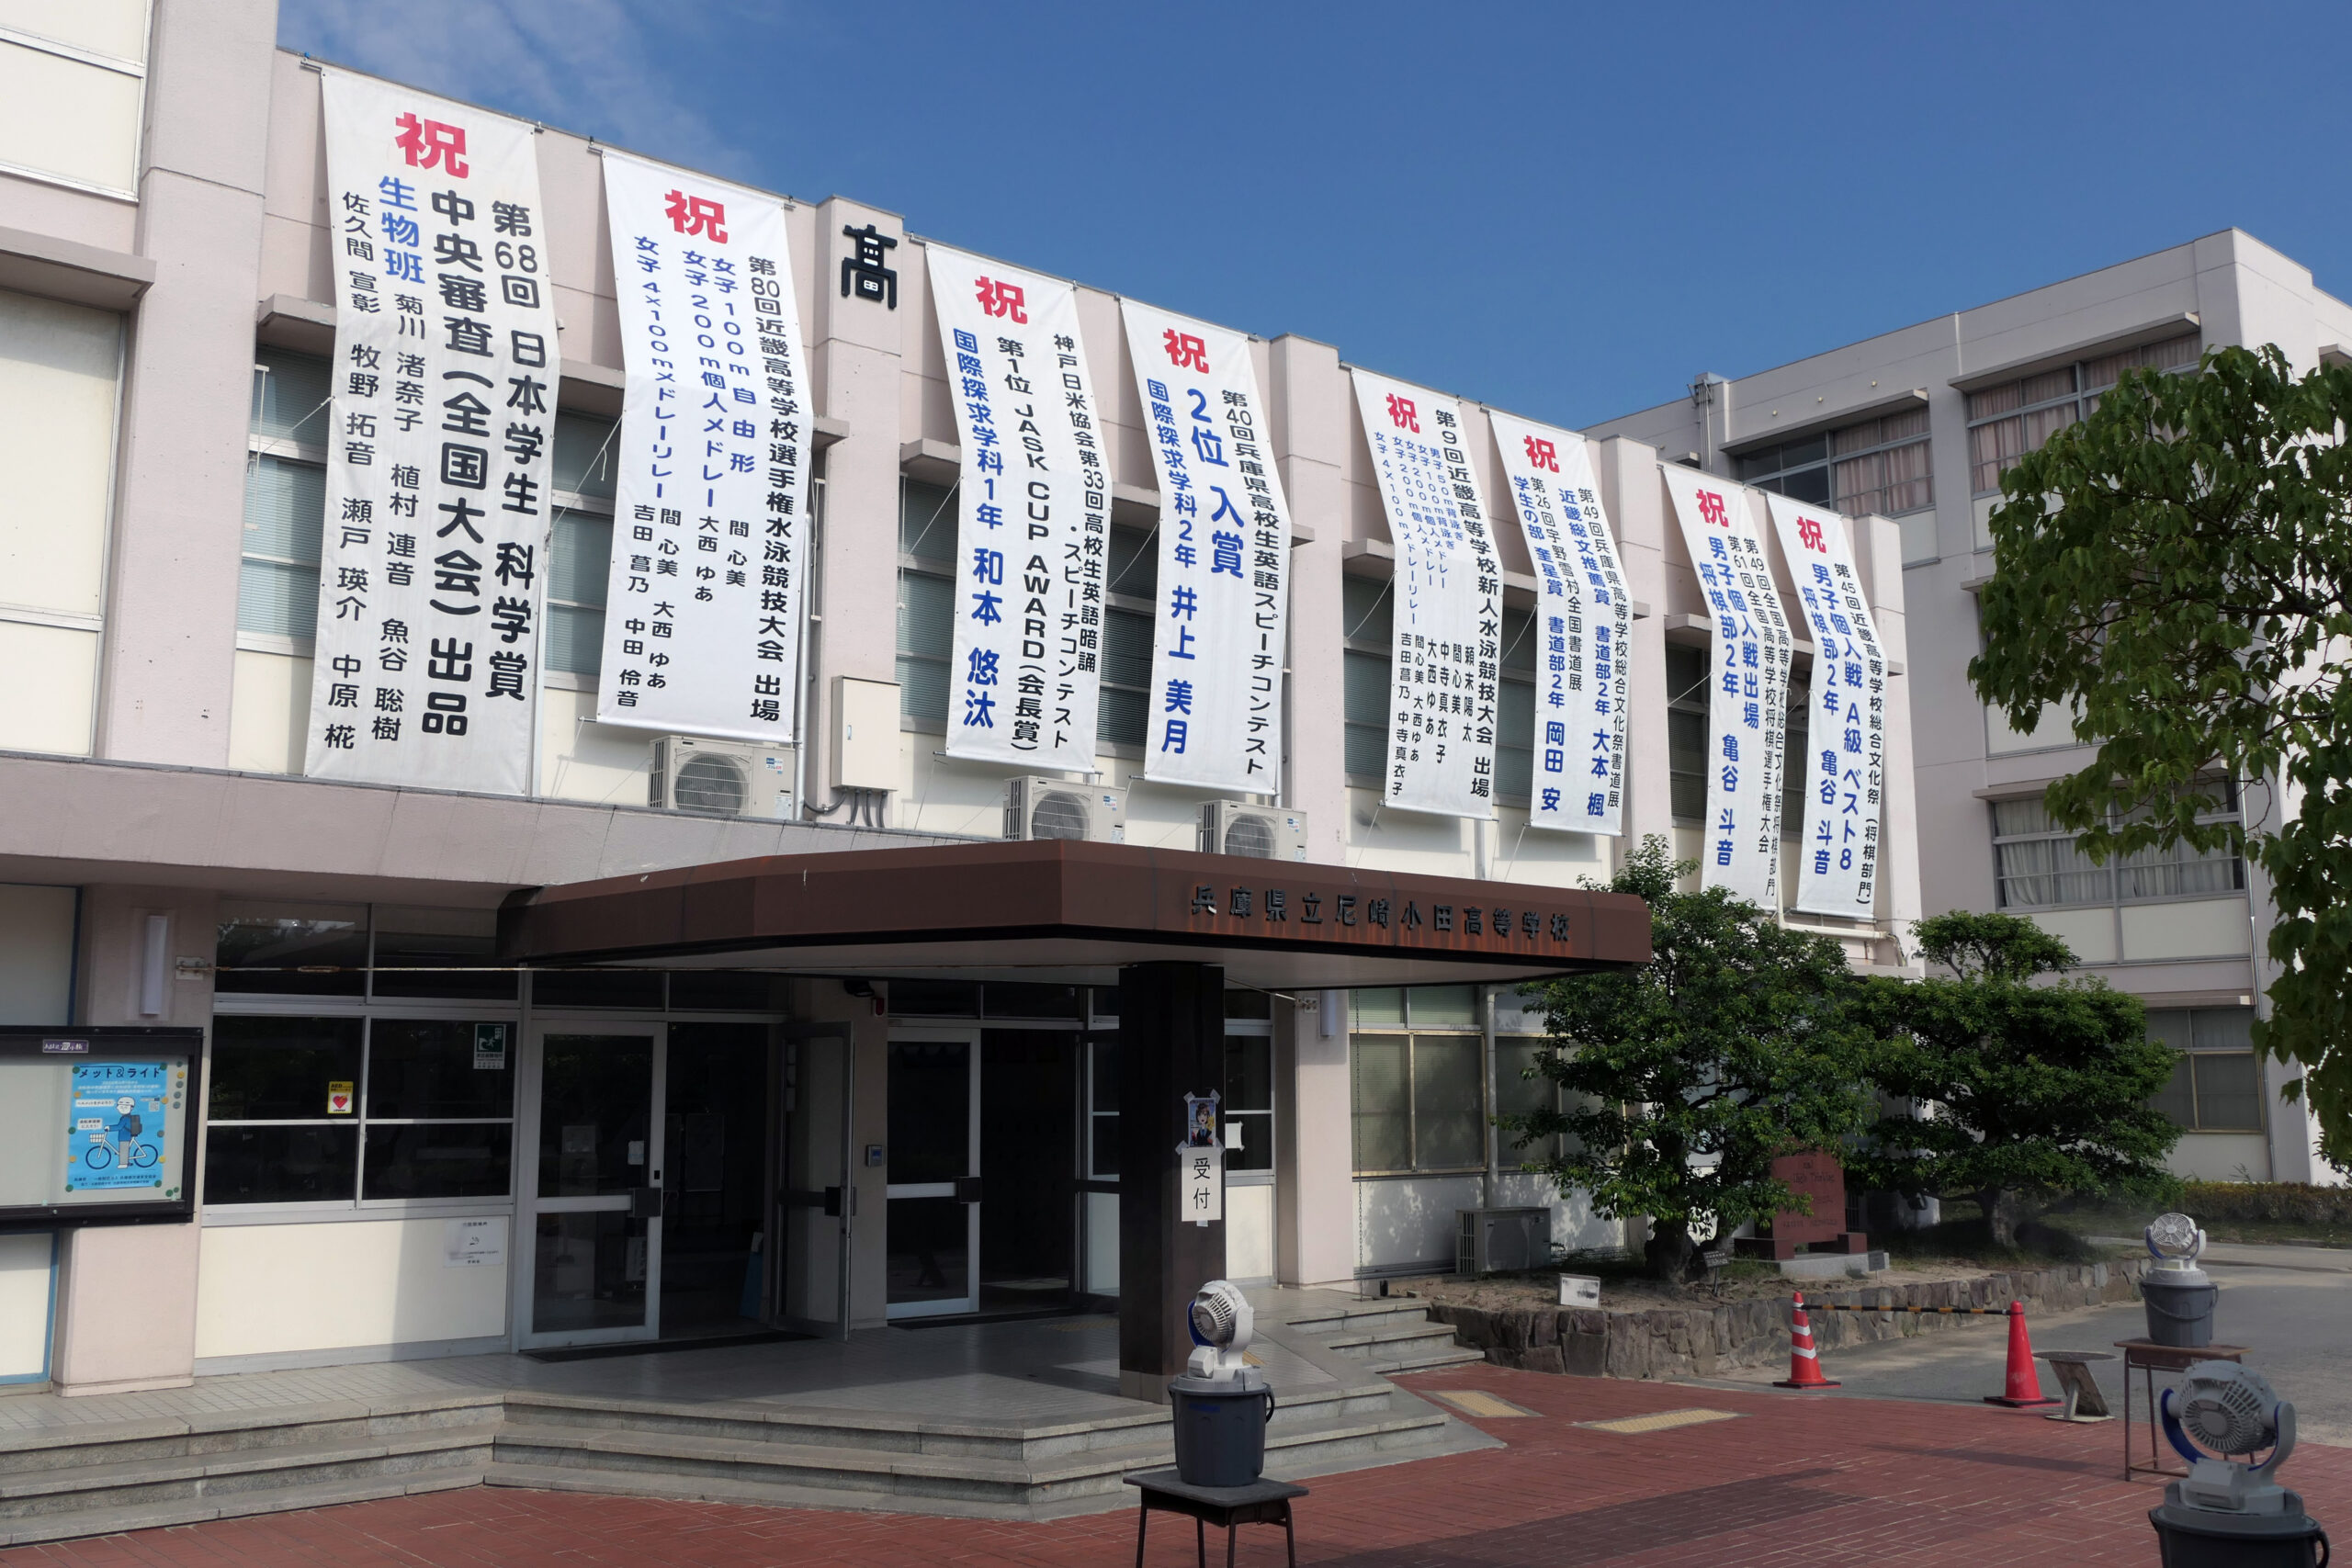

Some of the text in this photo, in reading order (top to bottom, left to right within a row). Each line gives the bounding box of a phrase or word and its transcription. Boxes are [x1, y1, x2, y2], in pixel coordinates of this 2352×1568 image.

[394, 112, 469, 182] 祝
[343, 192, 373, 261] 佐久間
[379, 176, 425, 284] 生物班
[665, 189, 728, 243] 祝
[394, 294, 424, 339] 菊川
[975, 276, 1027, 324] 祝
[348, 344, 380, 398] 牧野
[997, 337, 1033, 394] 第1位
[1163, 329, 1209, 374] 祝
[394, 352, 425, 432] 渚奈子
[1386, 393, 1419, 434] 祝
[345, 412, 377, 466] 拓音
[1015, 404, 1048, 470] JASK
[1523, 435, 1559, 473] 祝
[390, 464, 420, 517] 植村
[1187, 389, 1244, 579] 2位 入賞
[1696, 490, 1729, 527] 祝
[633, 505, 655, 541] 吉田
[698, 516, 718, 552] 大西
[1028, 482, 1049, 540] CUP
[1797, 516, 1826, 553] 祝
[386, 532, 415, 586] 連音
[695, 567, 715, 602] ゆあ
[972, 548, 1003, 626] 和本
[379, 618, 408, 671] 魚谷
[624, 618, 645, 655] 中田
[652, 602, 674, 637] 大西
[1169, 585, 1197, 660] 井上
[328, 654, 361, 707] 中原
[648, 653, 669, 688] ゆあ
[964, 648, 1000, 728] 悠汰
[1548, 616, 1565, 708] 書道部2年
[1595, 626, 1611, 716] 書道部2年
[751, 675, 780, 721] 出場
[1161, 679, 1193, 754] 美月
[1545, 721, 1565, 773] 岡田
[1591, 728, 1611, 778] 大本
[1844, 703, 1861, 754] A級
[1471, 757, 1490, 797] 出場
[1722, 734, 1738, 792] 亀谷
[1820, 750, 1837, 805] 亀谷
[1542, 787, 1560, 811] 安
[1840, 769, 1861, 870] ベスト8
[1717, 808, 1735, 865] 斗音
[1815, 820, 1832, 874] 斗音
[1193, 1157, 1210, 1210] 受付
